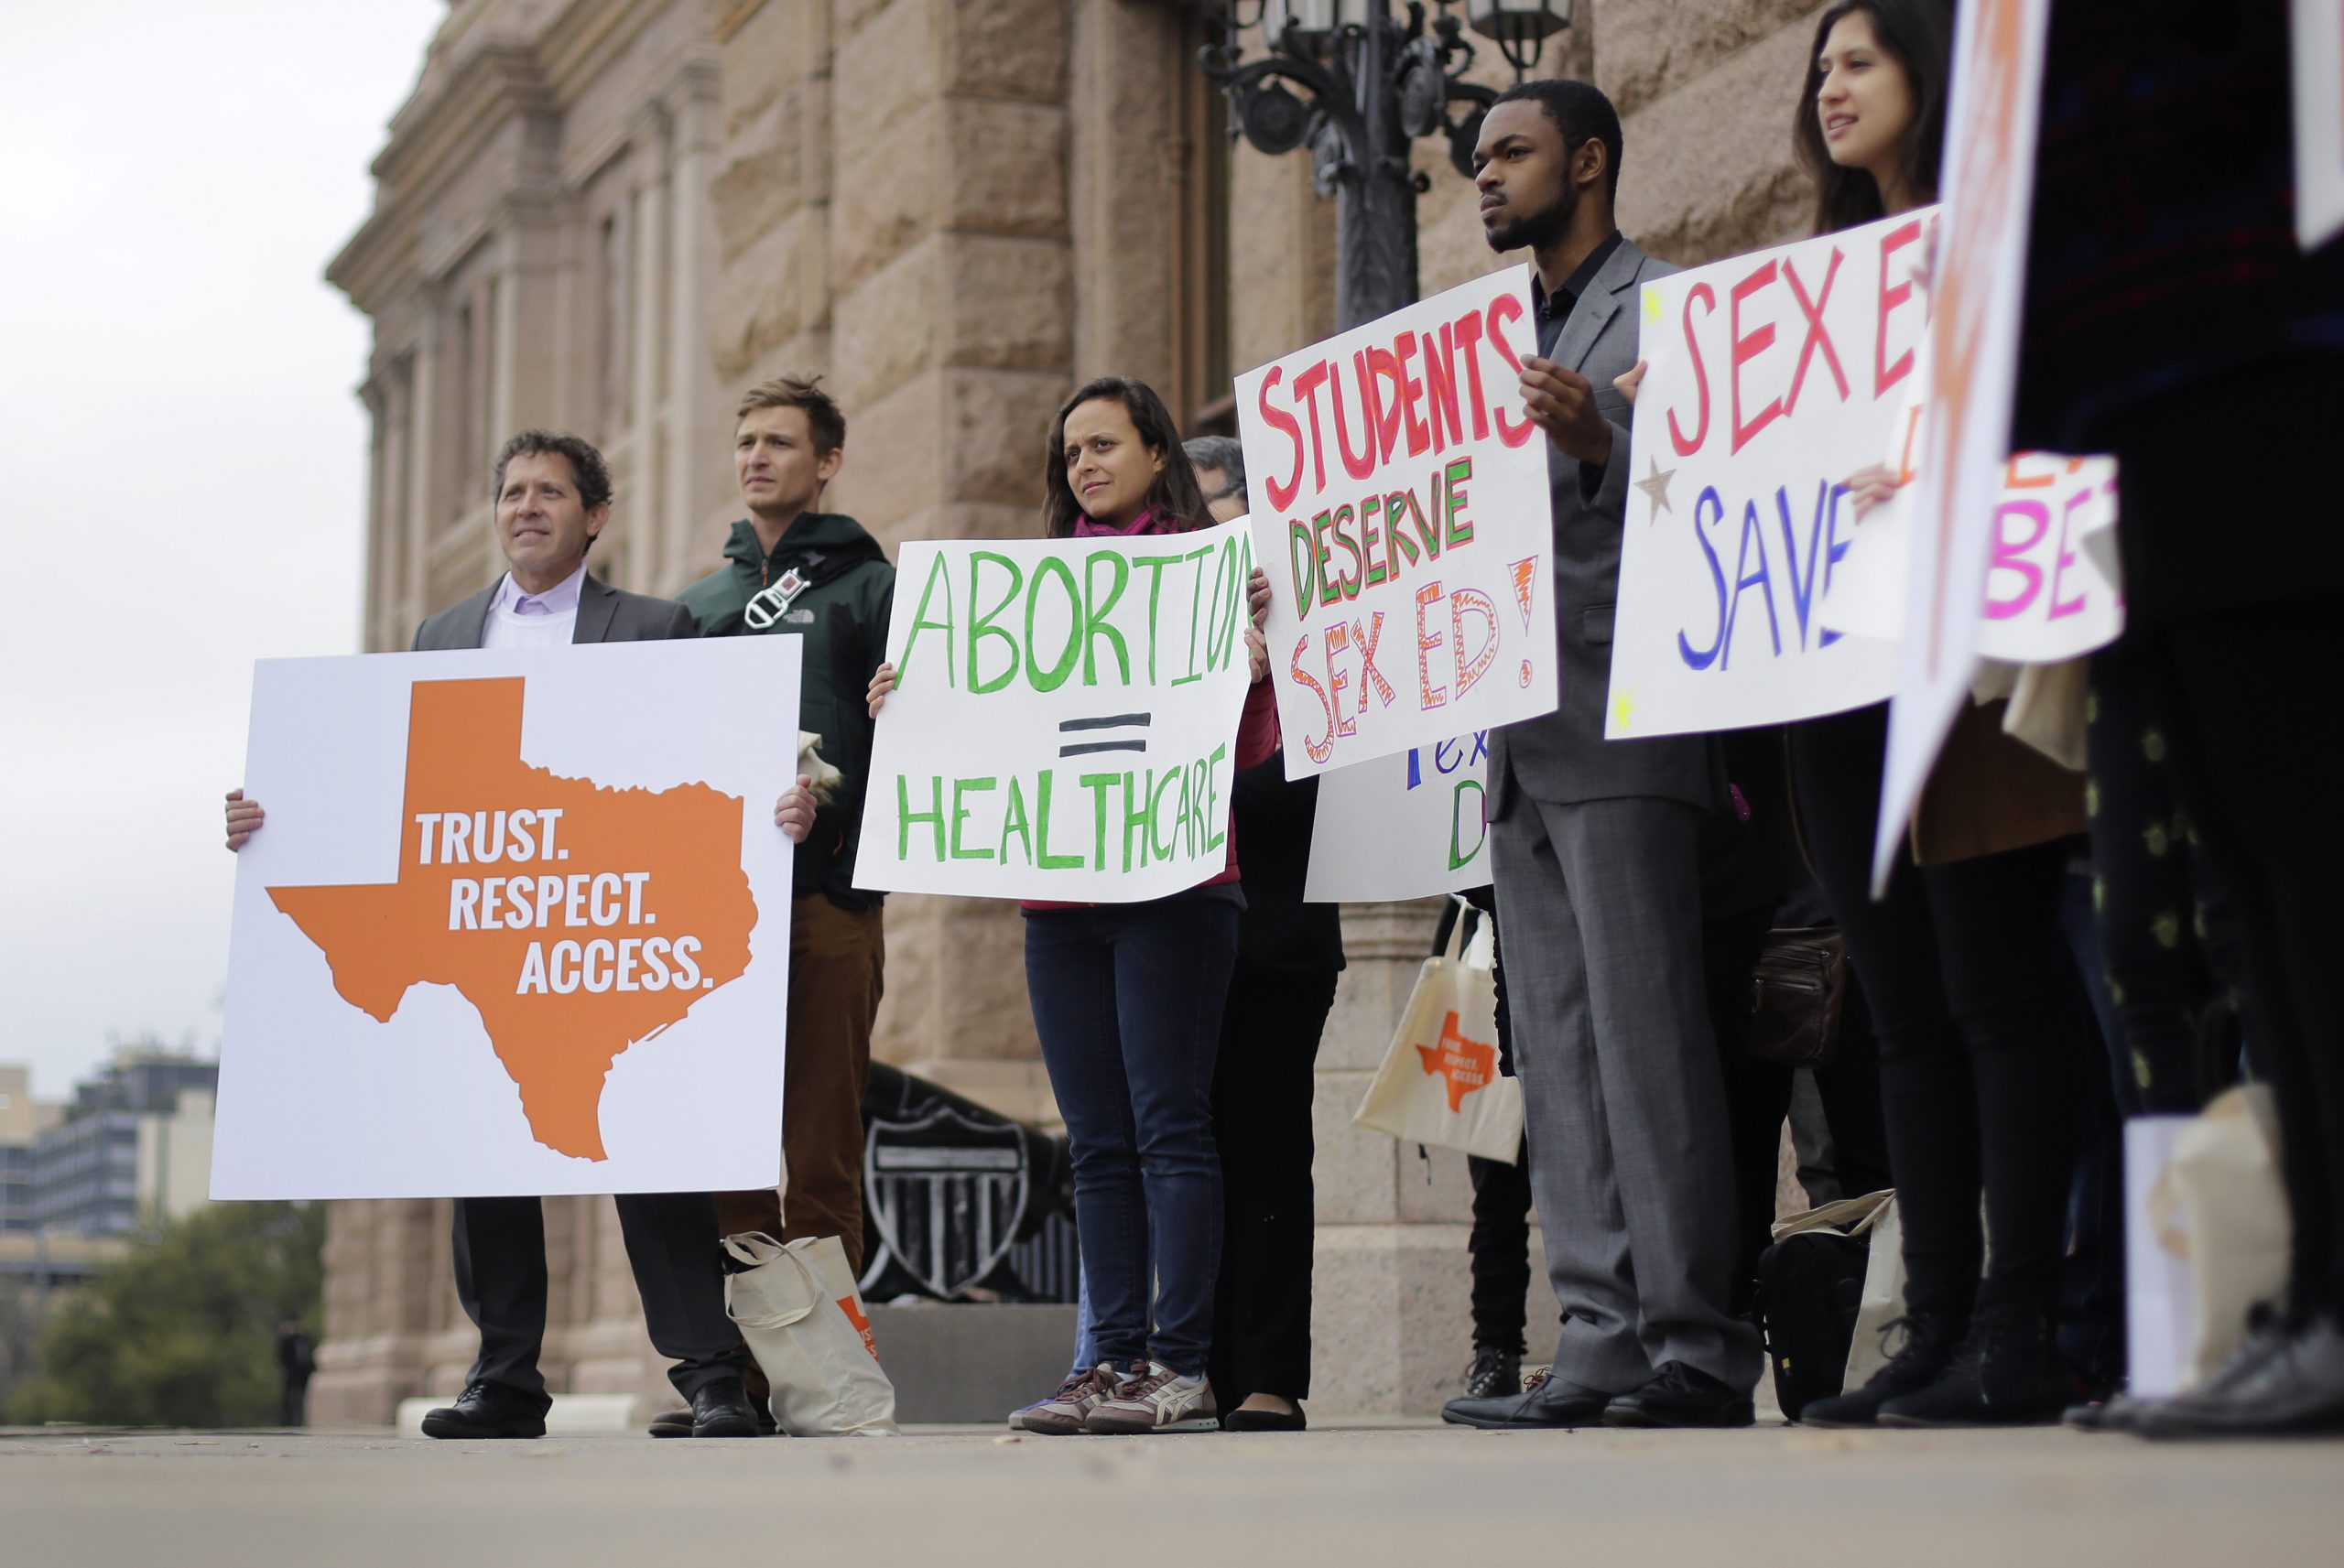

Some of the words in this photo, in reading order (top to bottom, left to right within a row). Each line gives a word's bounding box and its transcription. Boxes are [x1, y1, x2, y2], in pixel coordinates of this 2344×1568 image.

[1258, 292, 1536, 513] STUDENTS
[1666, 244, 1851, 458] SEX
[1874, 211, 1940, 401] E
[892, 530, 1253, 695] ABORTION
[1289, 455, 1475, 622] DESERVE
[1291, 611, 1396, 764] SEX
[1415, 554, 1539, 712] ED!
[415, 808, 570, 865] TRUST.
[896, 741, 1226, 874] HEALTHCARE
[448, 871, 657, 931] RESPECT.
[515, 935, 714, 995] ACCESS.
